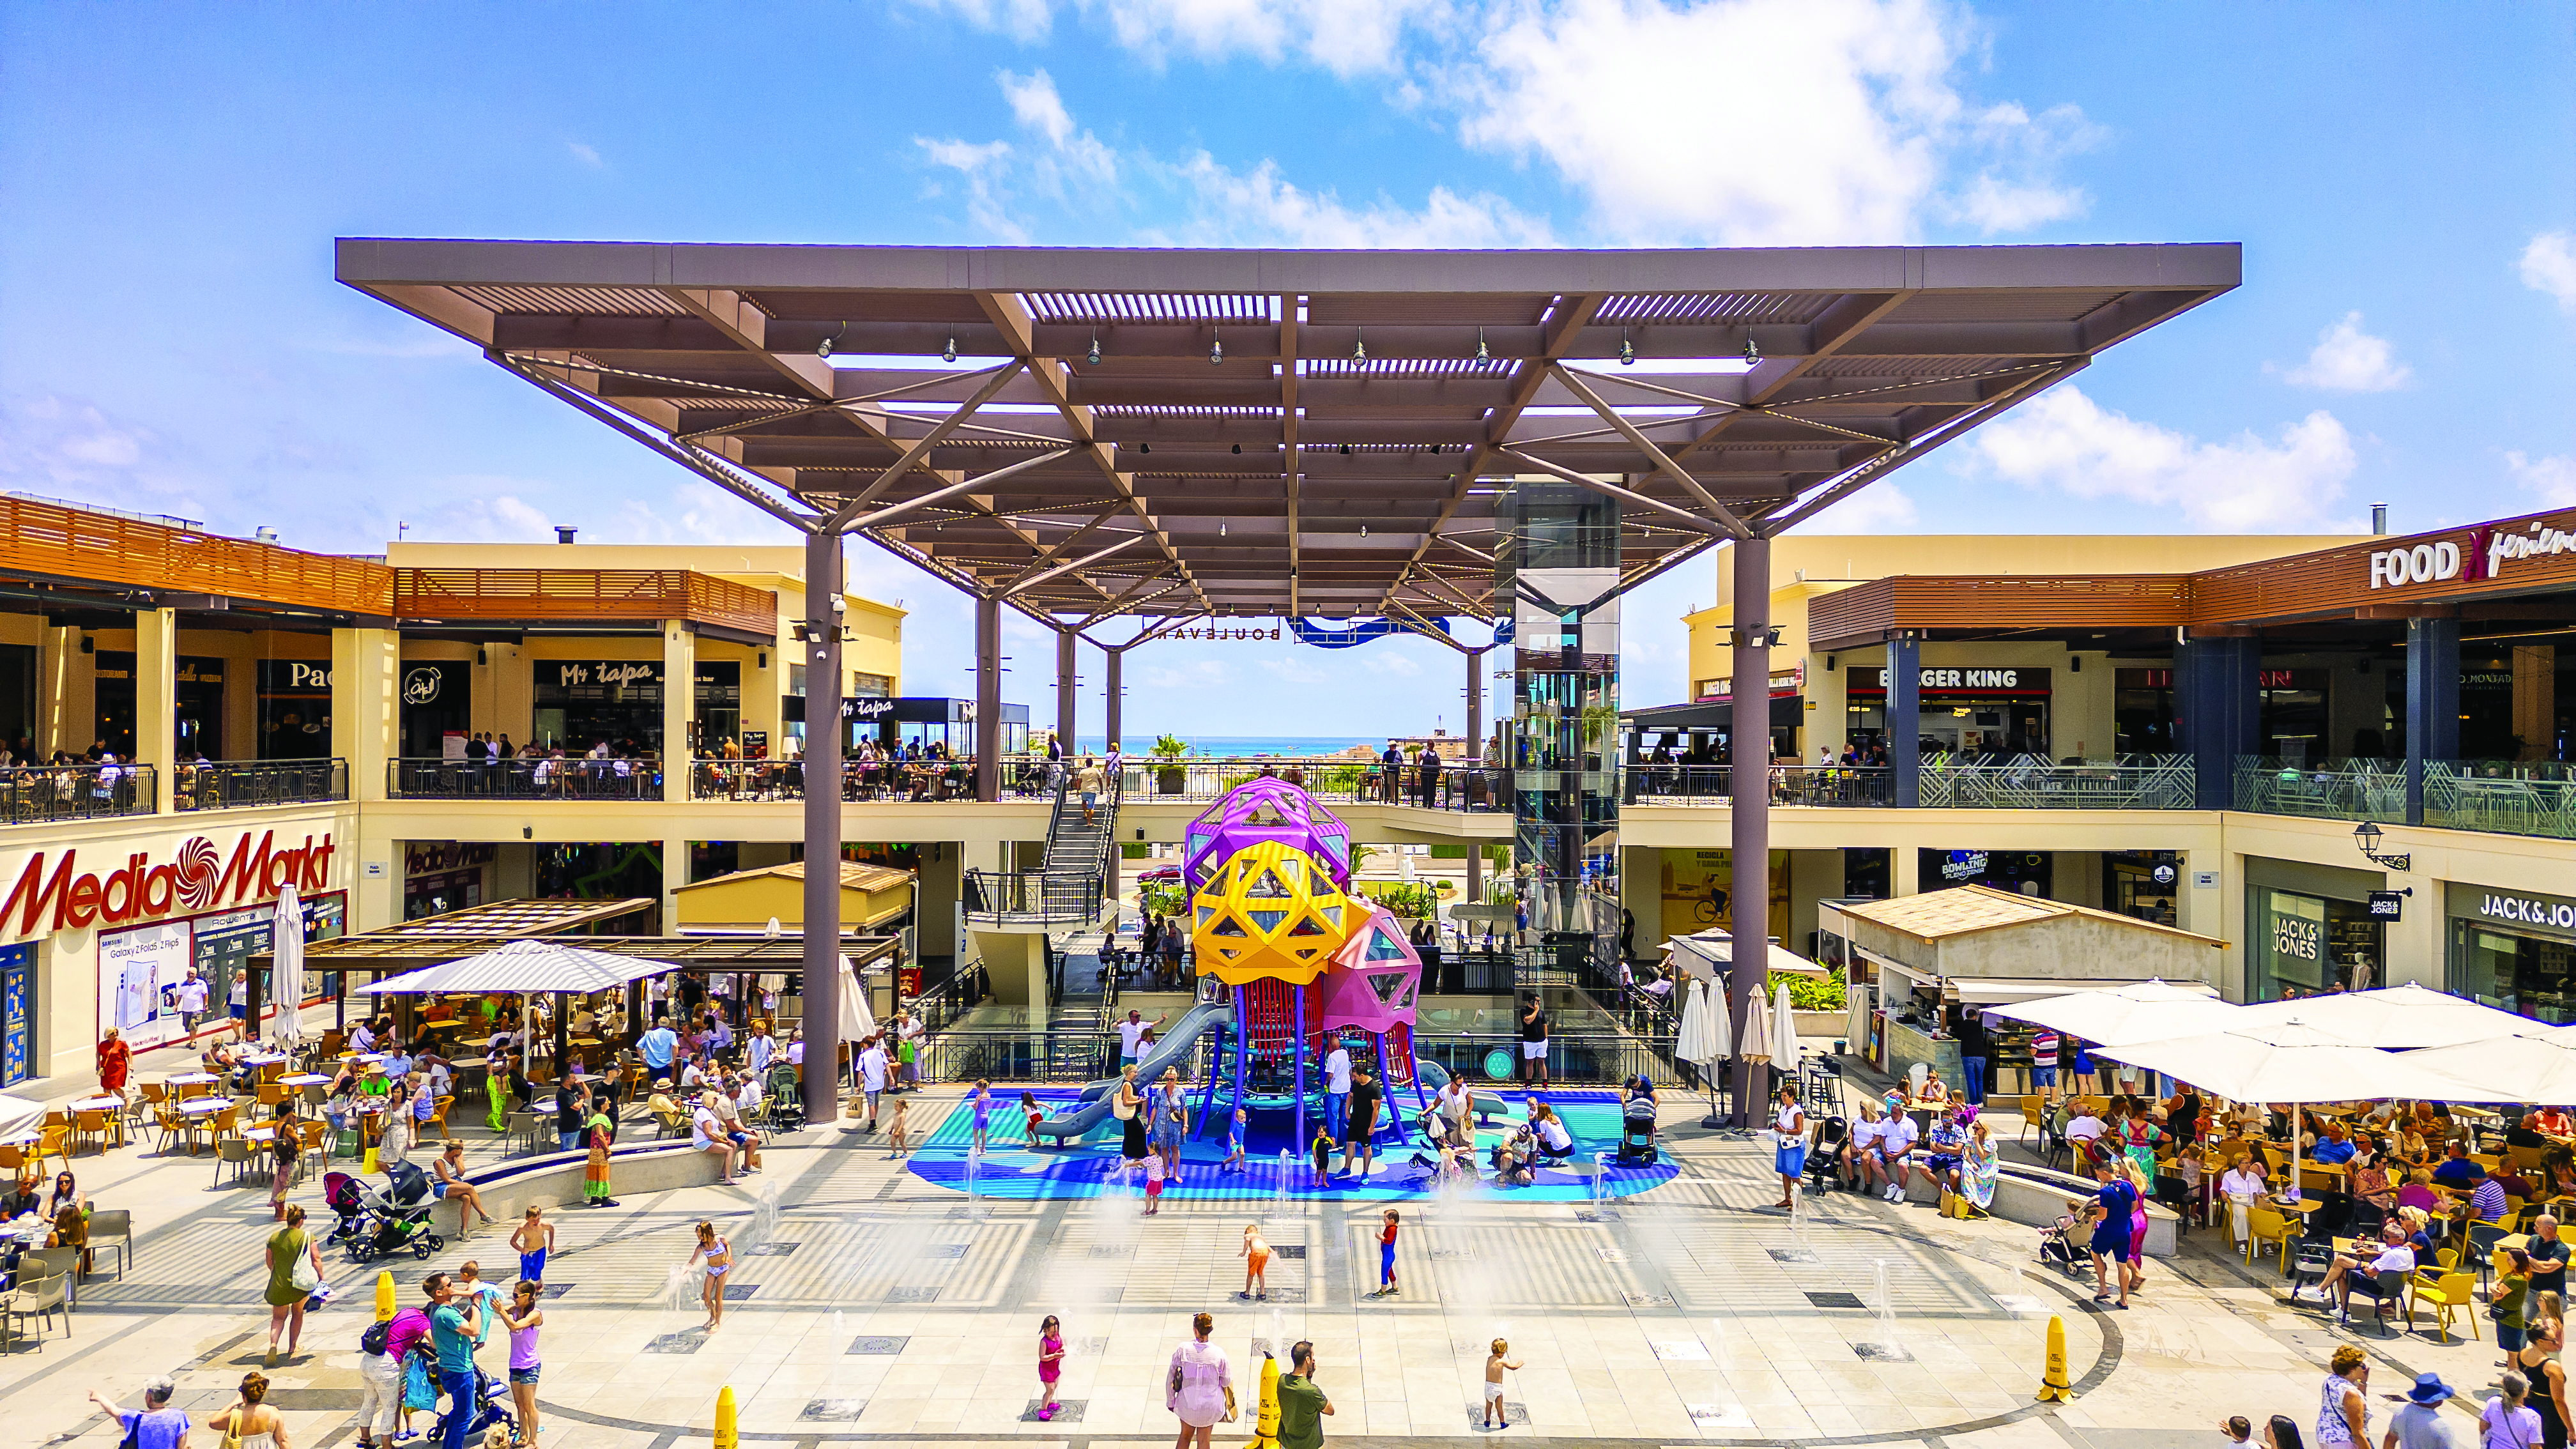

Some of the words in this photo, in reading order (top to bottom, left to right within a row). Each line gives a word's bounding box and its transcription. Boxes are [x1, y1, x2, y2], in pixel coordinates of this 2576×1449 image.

[2371, 542, 2460, 588] FOOD
[562, 664, 588, 687] My
[595, 662, 653, 688] tapa
[1880, 670, 1961, 687] BGER
[1966, 670, 2017, 687] KING
[1703, 680, 1720, 696] BURGER
[1720, 679, 1731, 694] KING
[857, 699, 894, 719] tapa
[1942, 859, 1986, 874] BOWLING
[0, 849, 176, 936] Media
[209, 829, 335, 906] Markt
[111, 947, 135, 959] Galaxy
[2273, 936, 2316, 960] JONES
